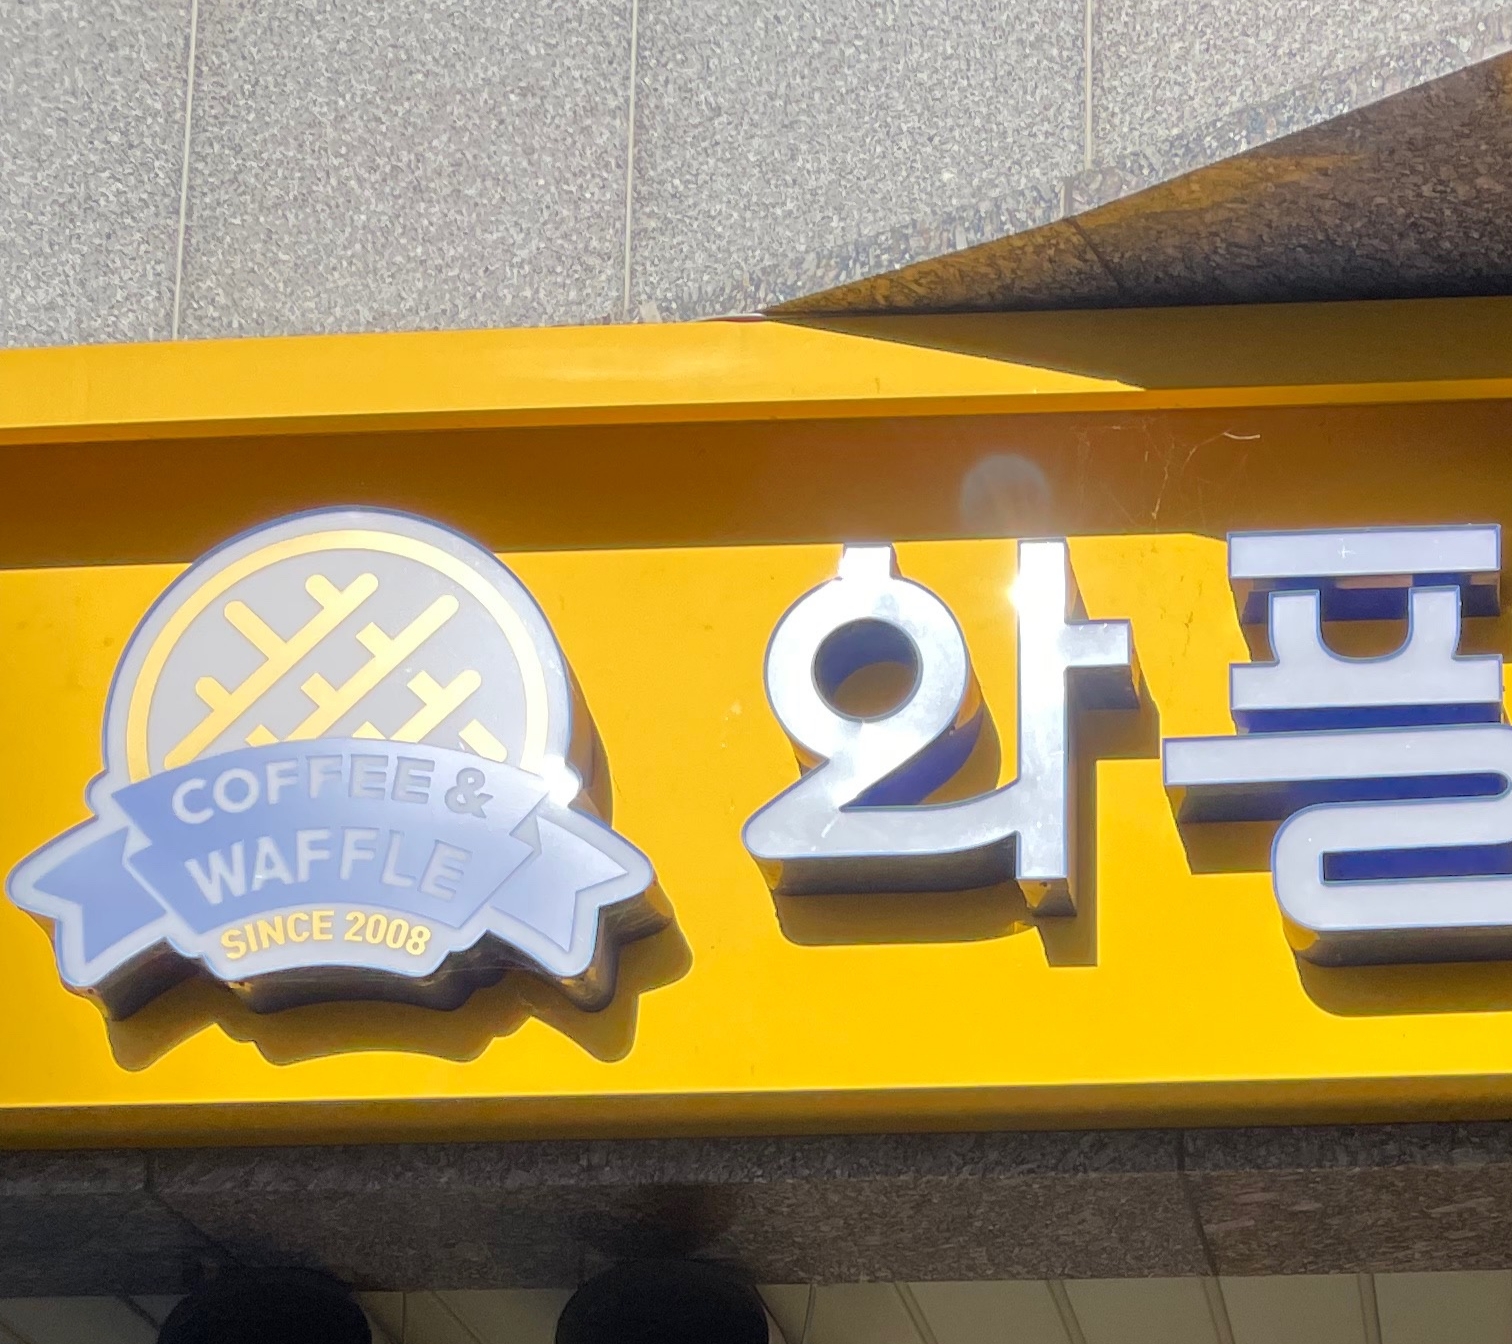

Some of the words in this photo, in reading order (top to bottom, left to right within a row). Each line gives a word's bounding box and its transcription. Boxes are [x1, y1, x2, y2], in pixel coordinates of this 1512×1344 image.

[172, 755, 432, 825] COFFEE
[444, 767, 493, 819] &
[185, 827, 471, 905] WAFFLE
[220, 910, 334, 960] SINCE
[344, 910, 431, 956] 2008
